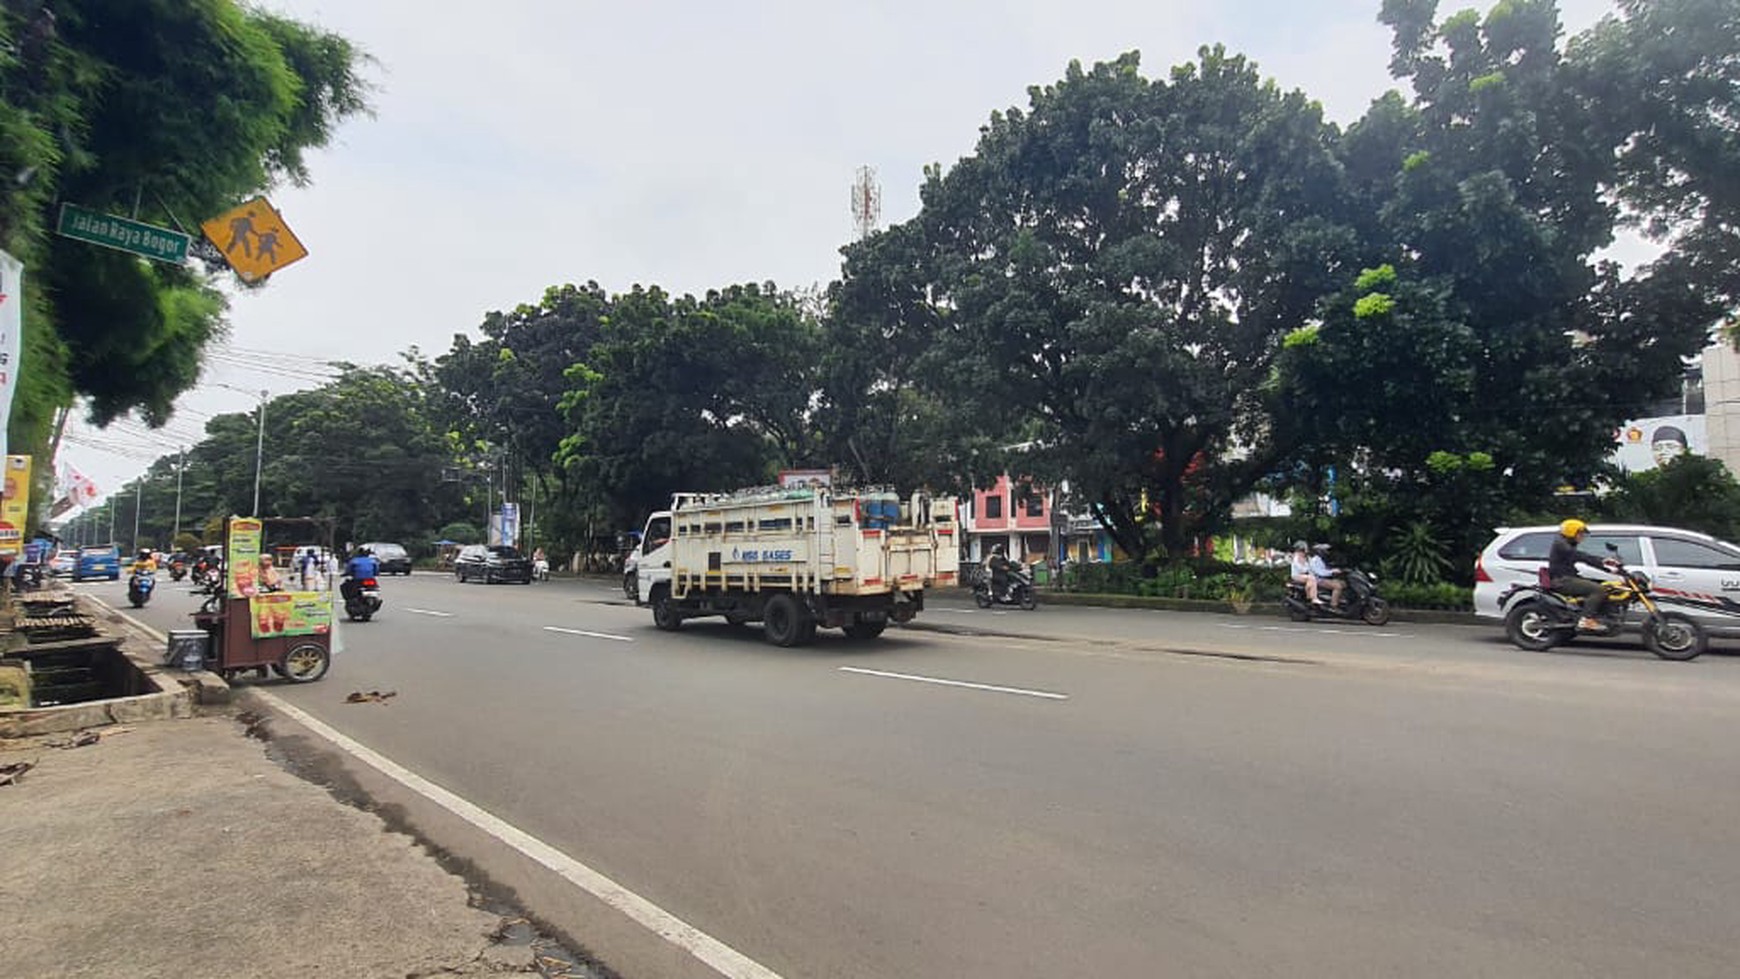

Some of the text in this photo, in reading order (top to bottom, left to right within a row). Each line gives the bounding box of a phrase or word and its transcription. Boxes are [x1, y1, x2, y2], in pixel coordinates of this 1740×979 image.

[72, 215, 180, 254] Jalan Raya Bogor
